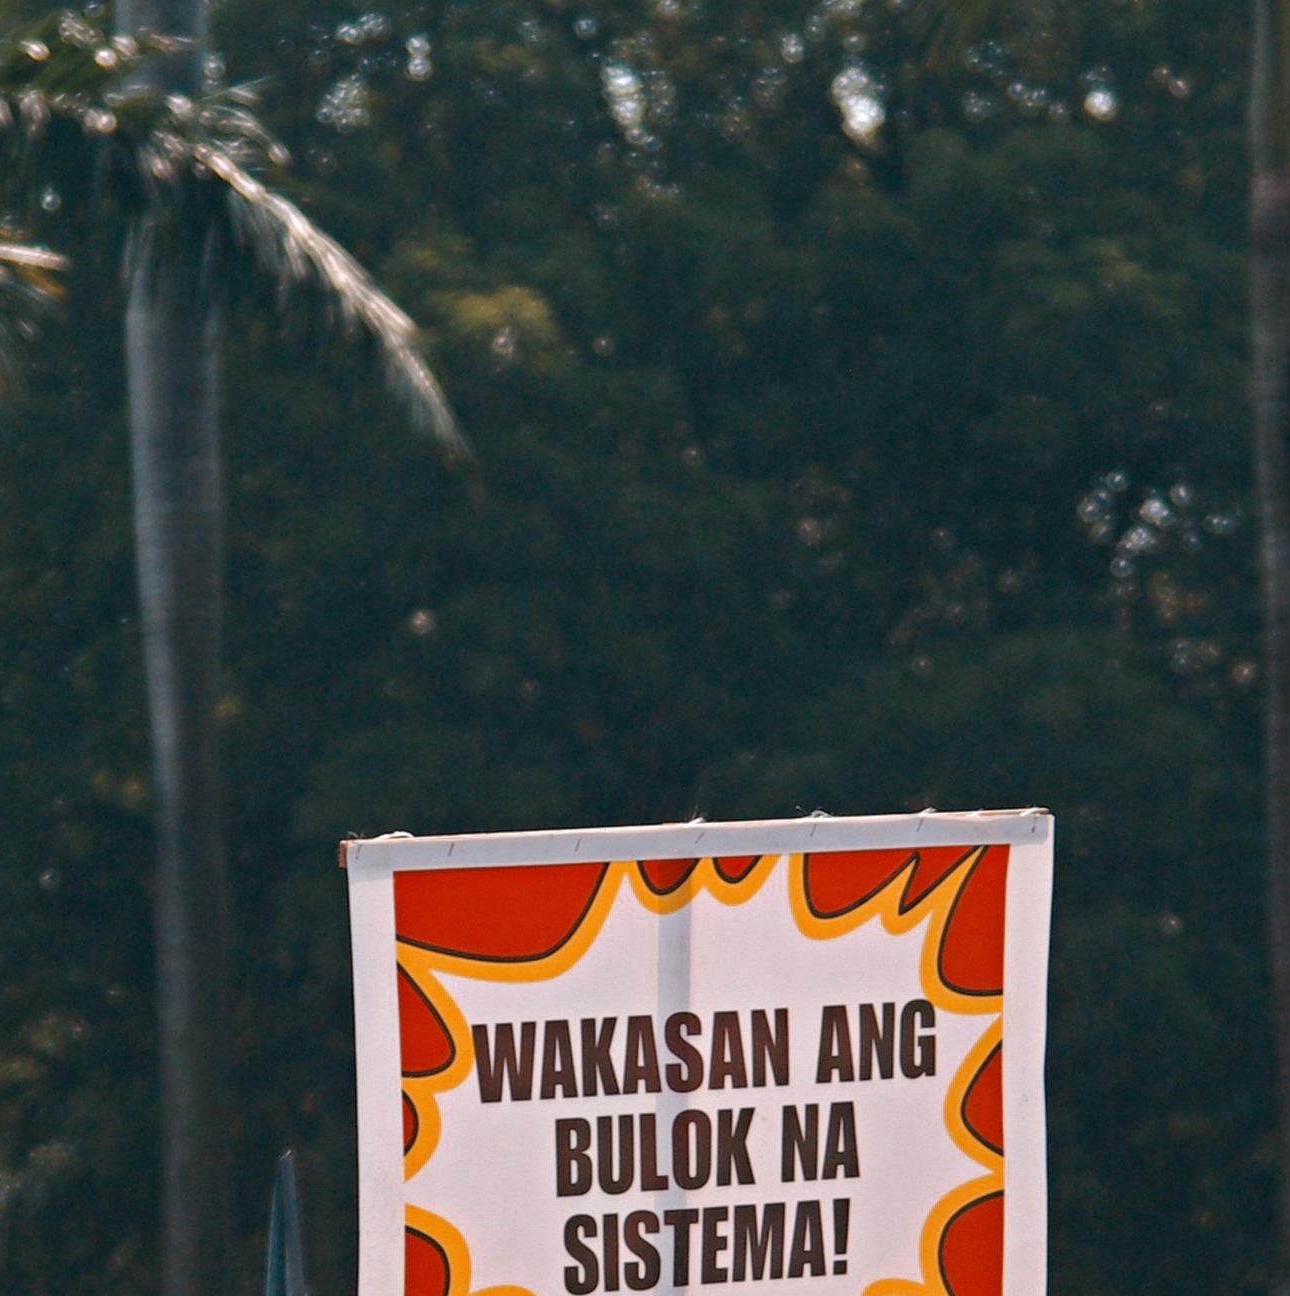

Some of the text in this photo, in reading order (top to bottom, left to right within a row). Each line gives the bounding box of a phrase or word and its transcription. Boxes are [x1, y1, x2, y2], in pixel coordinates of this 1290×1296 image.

[471, 998, 937, 1104] WAKASAN ANG
[554, 1100, 861, 1198] BULOK NA
[562, 1197, 852, 1296] SISTEMA!
